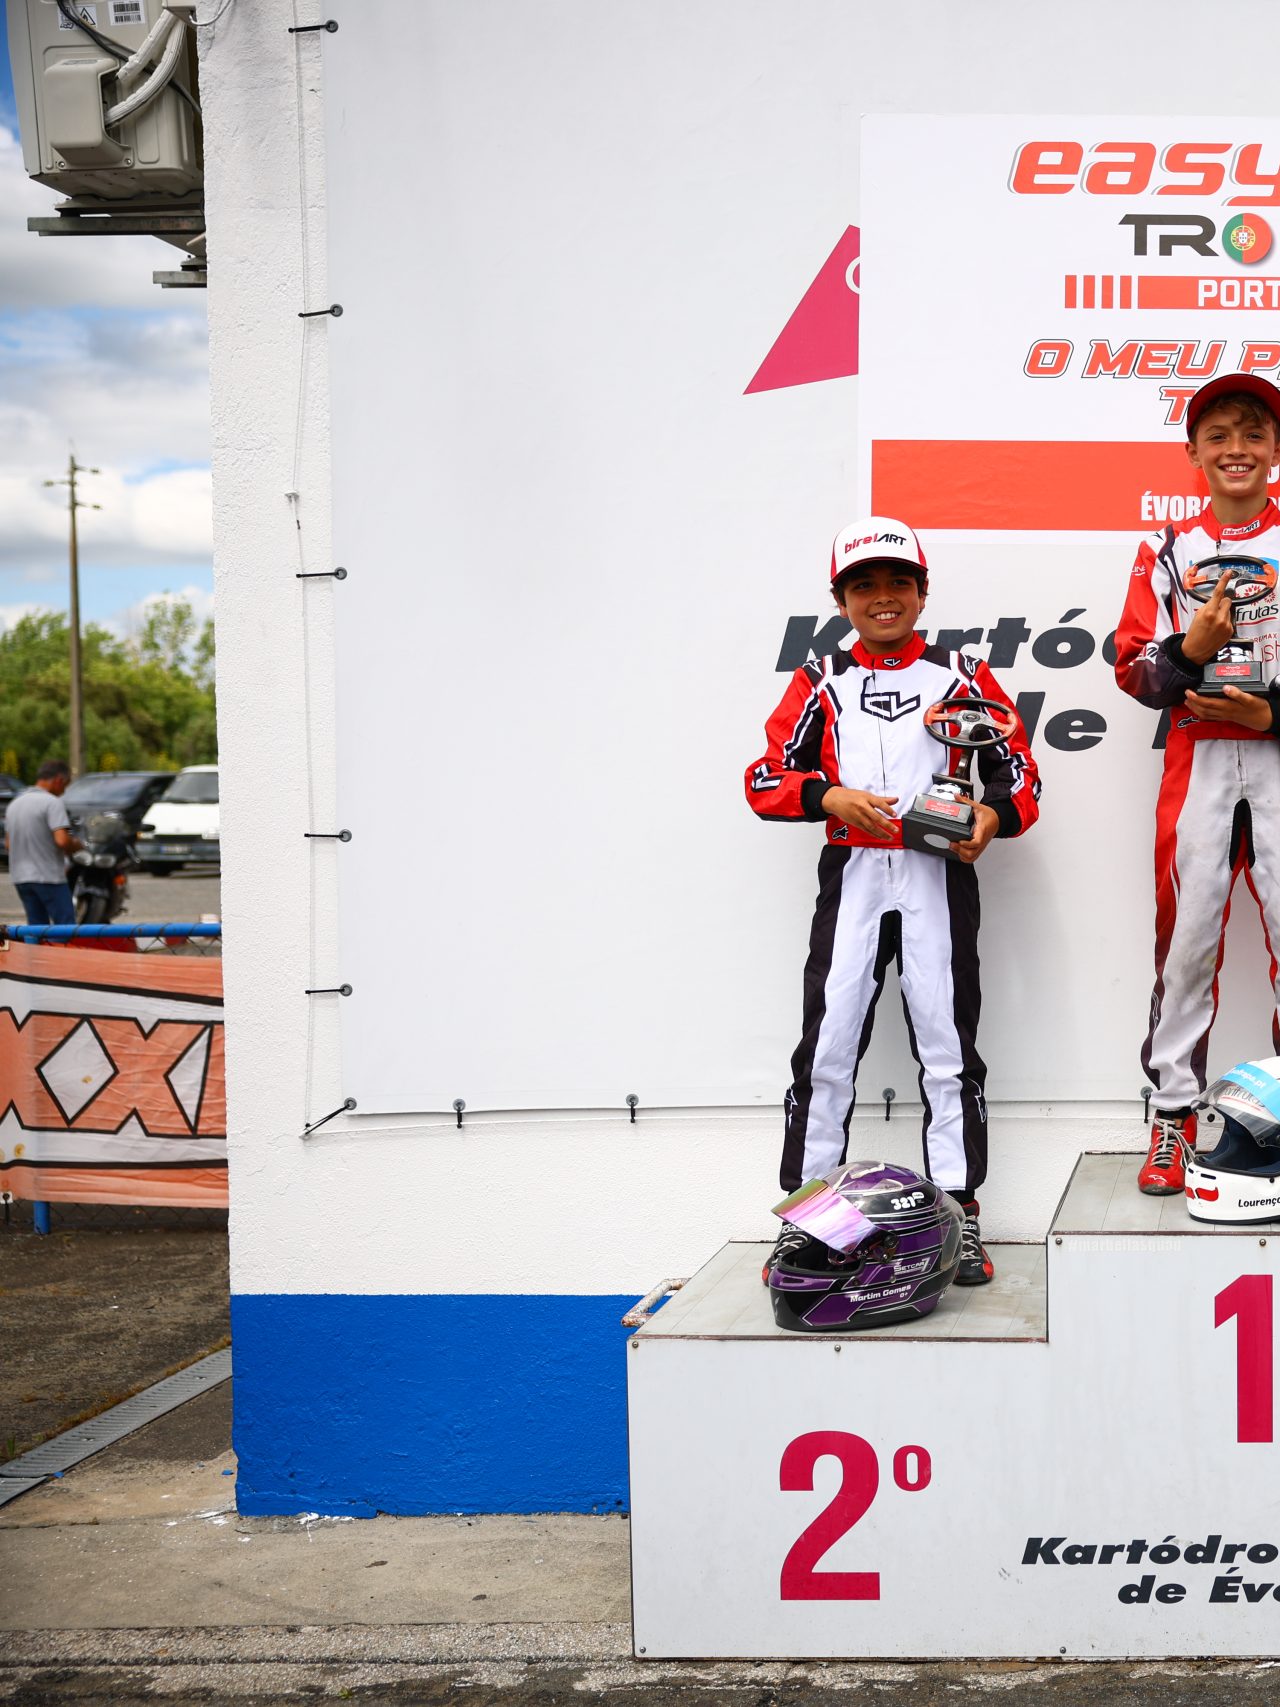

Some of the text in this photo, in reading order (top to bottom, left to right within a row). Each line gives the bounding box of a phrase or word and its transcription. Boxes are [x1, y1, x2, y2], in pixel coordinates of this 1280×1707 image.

[1023, 339, 1074, 378] O
[1082, 340, 1227, 379] MEU
[882, 1284, 912, 1297] Gomes
[1117, 1574, 1187, 1605] de
